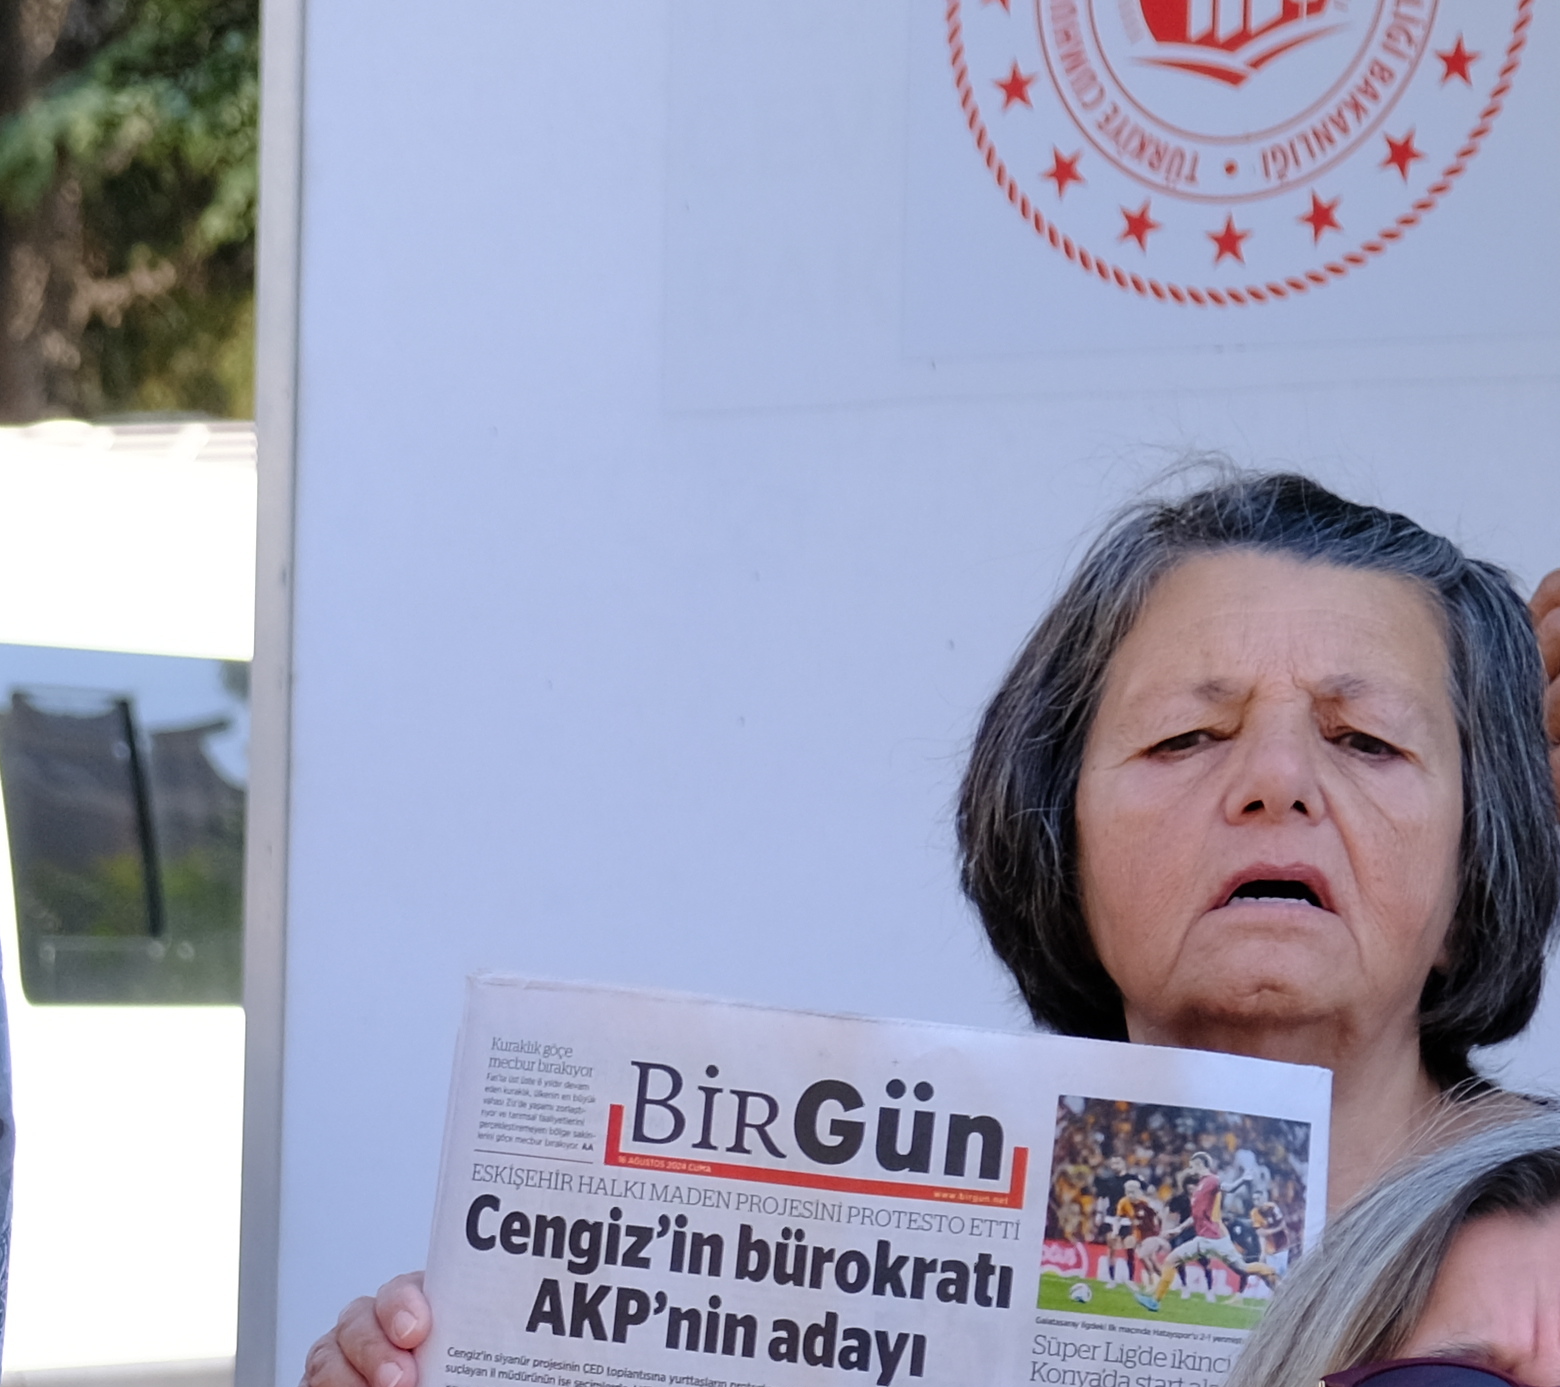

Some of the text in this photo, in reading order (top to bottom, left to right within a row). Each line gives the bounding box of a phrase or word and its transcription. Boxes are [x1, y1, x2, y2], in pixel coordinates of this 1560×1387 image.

[488, 1057, 536, 1071] mecbur
[491, 1037, 573, 1060] Kuraklık göçe
[472, 1163, 1020, 1240] ESKİŞEHİR HALKI MADEN PROJESİNİ PROTESTO ETTİ
[466, 1194, 1013, 1308] Cengiz'in bürokratı
[526, 1278, 926, 1387] AKP'nin adayı
[448, 1347, 492, 1361] Cengiz'in
[494, 1353, 530, 1366] siyanür
[532, 1359, 580, 1372] projesinin
[607, 1366, 666, 1382] toplantısına
[1032, 1334, 1101, 1362] Süper
[1104, 1342, 1167, 1369] Lig'de
[446, 1364, 488, 1377] suçlayan
[498, 1370, 555, 1384] müdürünün
